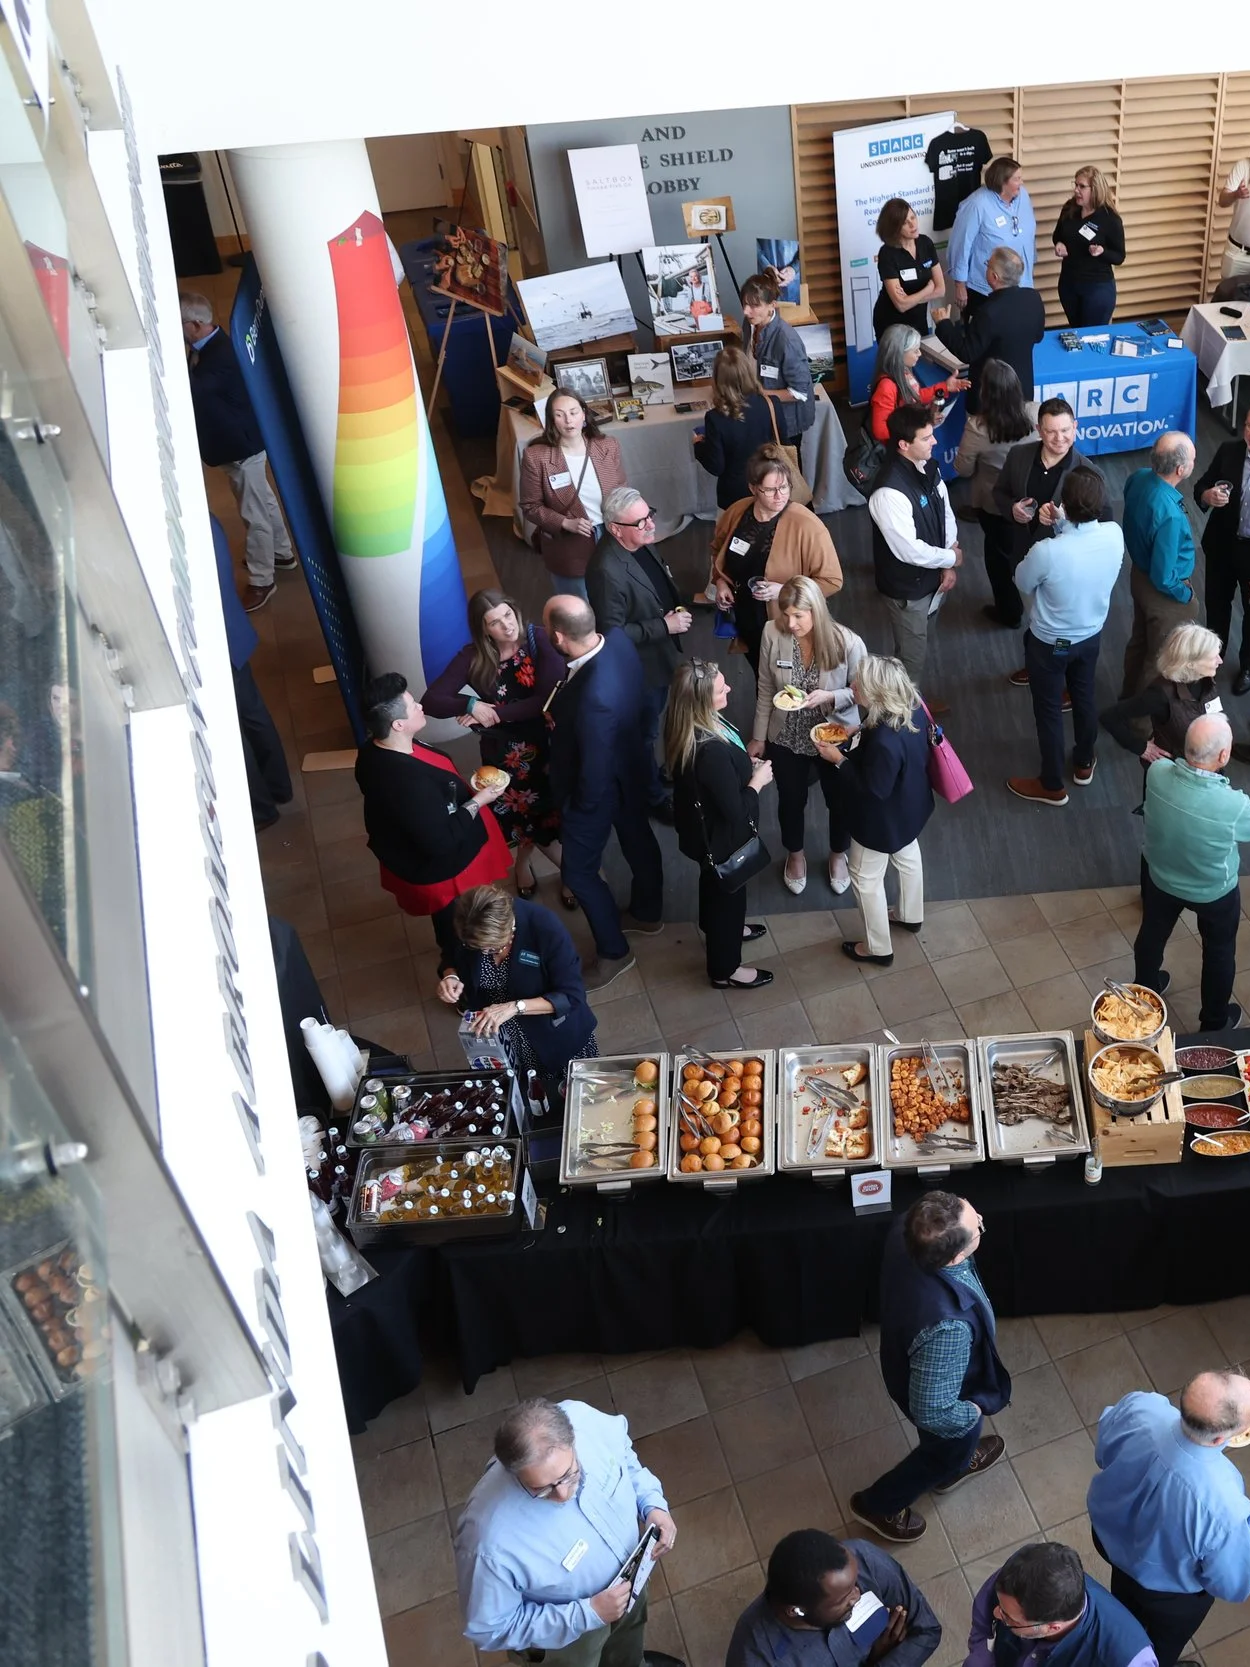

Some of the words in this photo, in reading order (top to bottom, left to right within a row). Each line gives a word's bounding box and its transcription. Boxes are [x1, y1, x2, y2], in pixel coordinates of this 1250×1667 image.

[641, 125, 686, 143] AND
[869, 135, 923, 156] STARC
[660, 148, 734, 168] SHIELD
[860, 157, 892, 169] UNDISRUPT
[893, 151, 927, 163] RENOVATIO
[854, 199, 868, 207] The
[869, 193, 896, 205] Highest
[898, 187, 930, 198] Standard
[863, 206, 881, 217] Reus
[1075, 418, 1169, 441] NOVATION.
